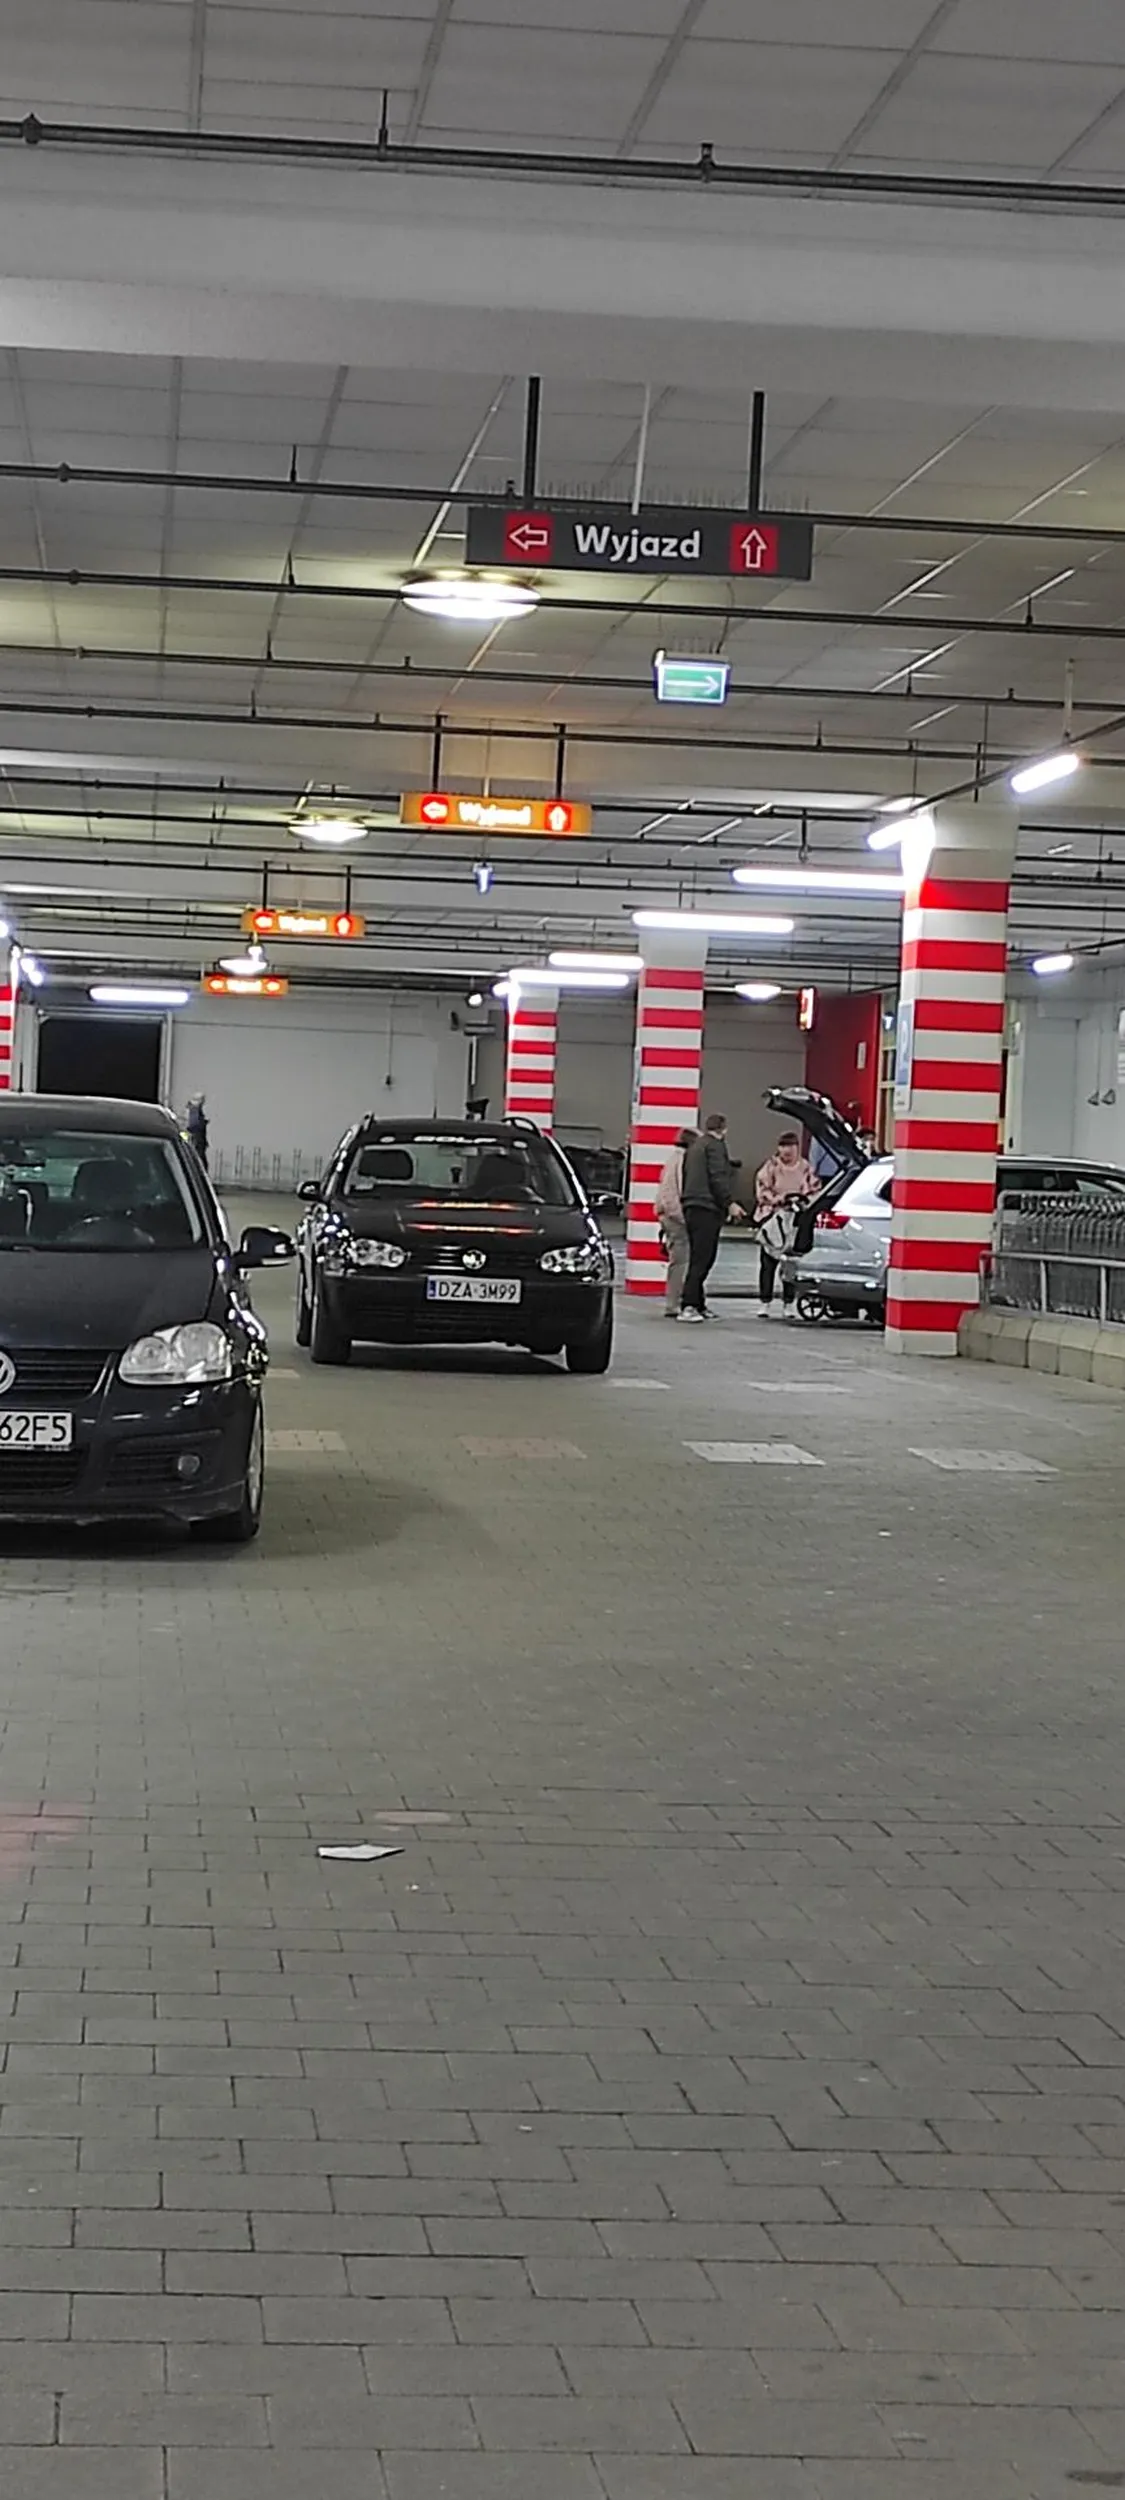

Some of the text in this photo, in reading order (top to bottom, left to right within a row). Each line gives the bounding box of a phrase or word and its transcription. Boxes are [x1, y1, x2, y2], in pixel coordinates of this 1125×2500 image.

[574, 524, 700, 563] Wyjazd
[458, 801, 532, 826] Wyjd
[439, 1281, 472, 1298] DZA
[479, 1283, 517, 1300] 3M99
[0, 1415, 67, 1442] 62F5
